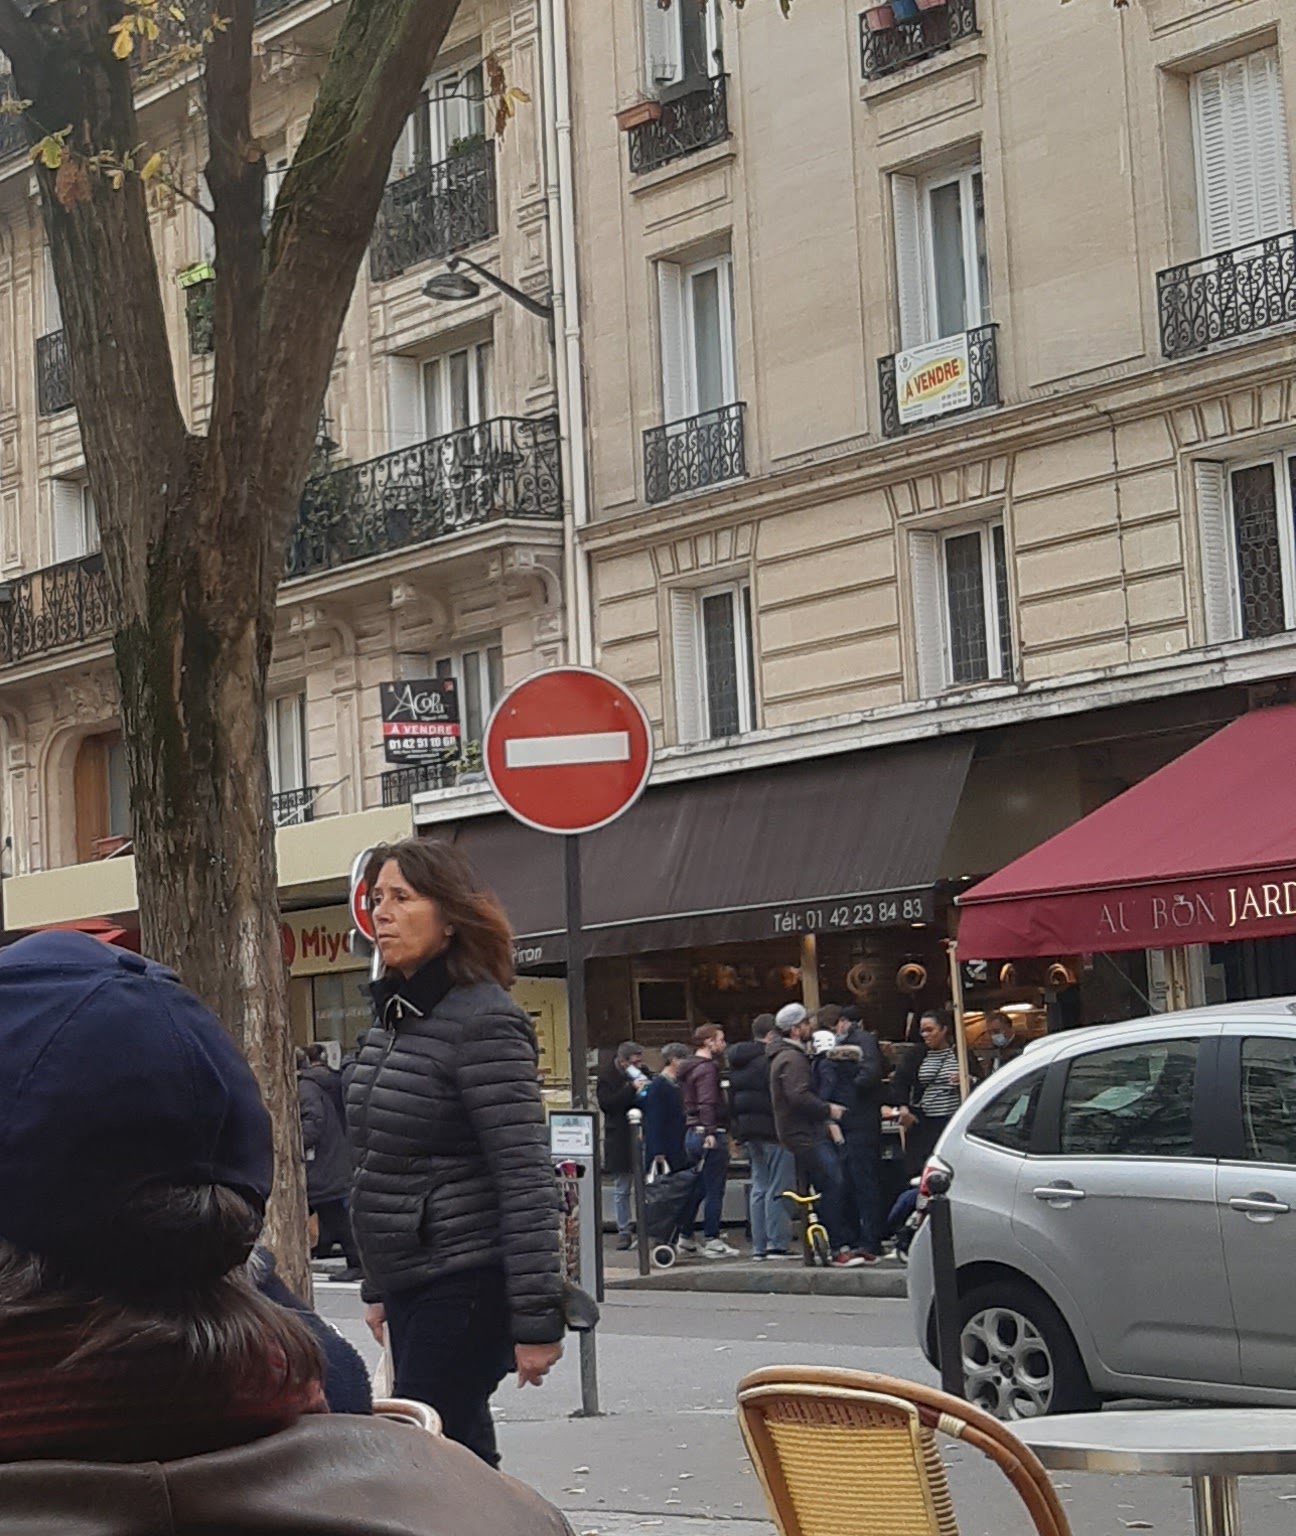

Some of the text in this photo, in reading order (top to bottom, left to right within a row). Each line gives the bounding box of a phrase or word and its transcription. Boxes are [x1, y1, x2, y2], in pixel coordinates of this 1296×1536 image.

[914, 357, 961, 394] VENDRE
[403, 724, 453, 735] VENDRE
[774, 898, 923, 933] Tél: 01 42 23 84 83
